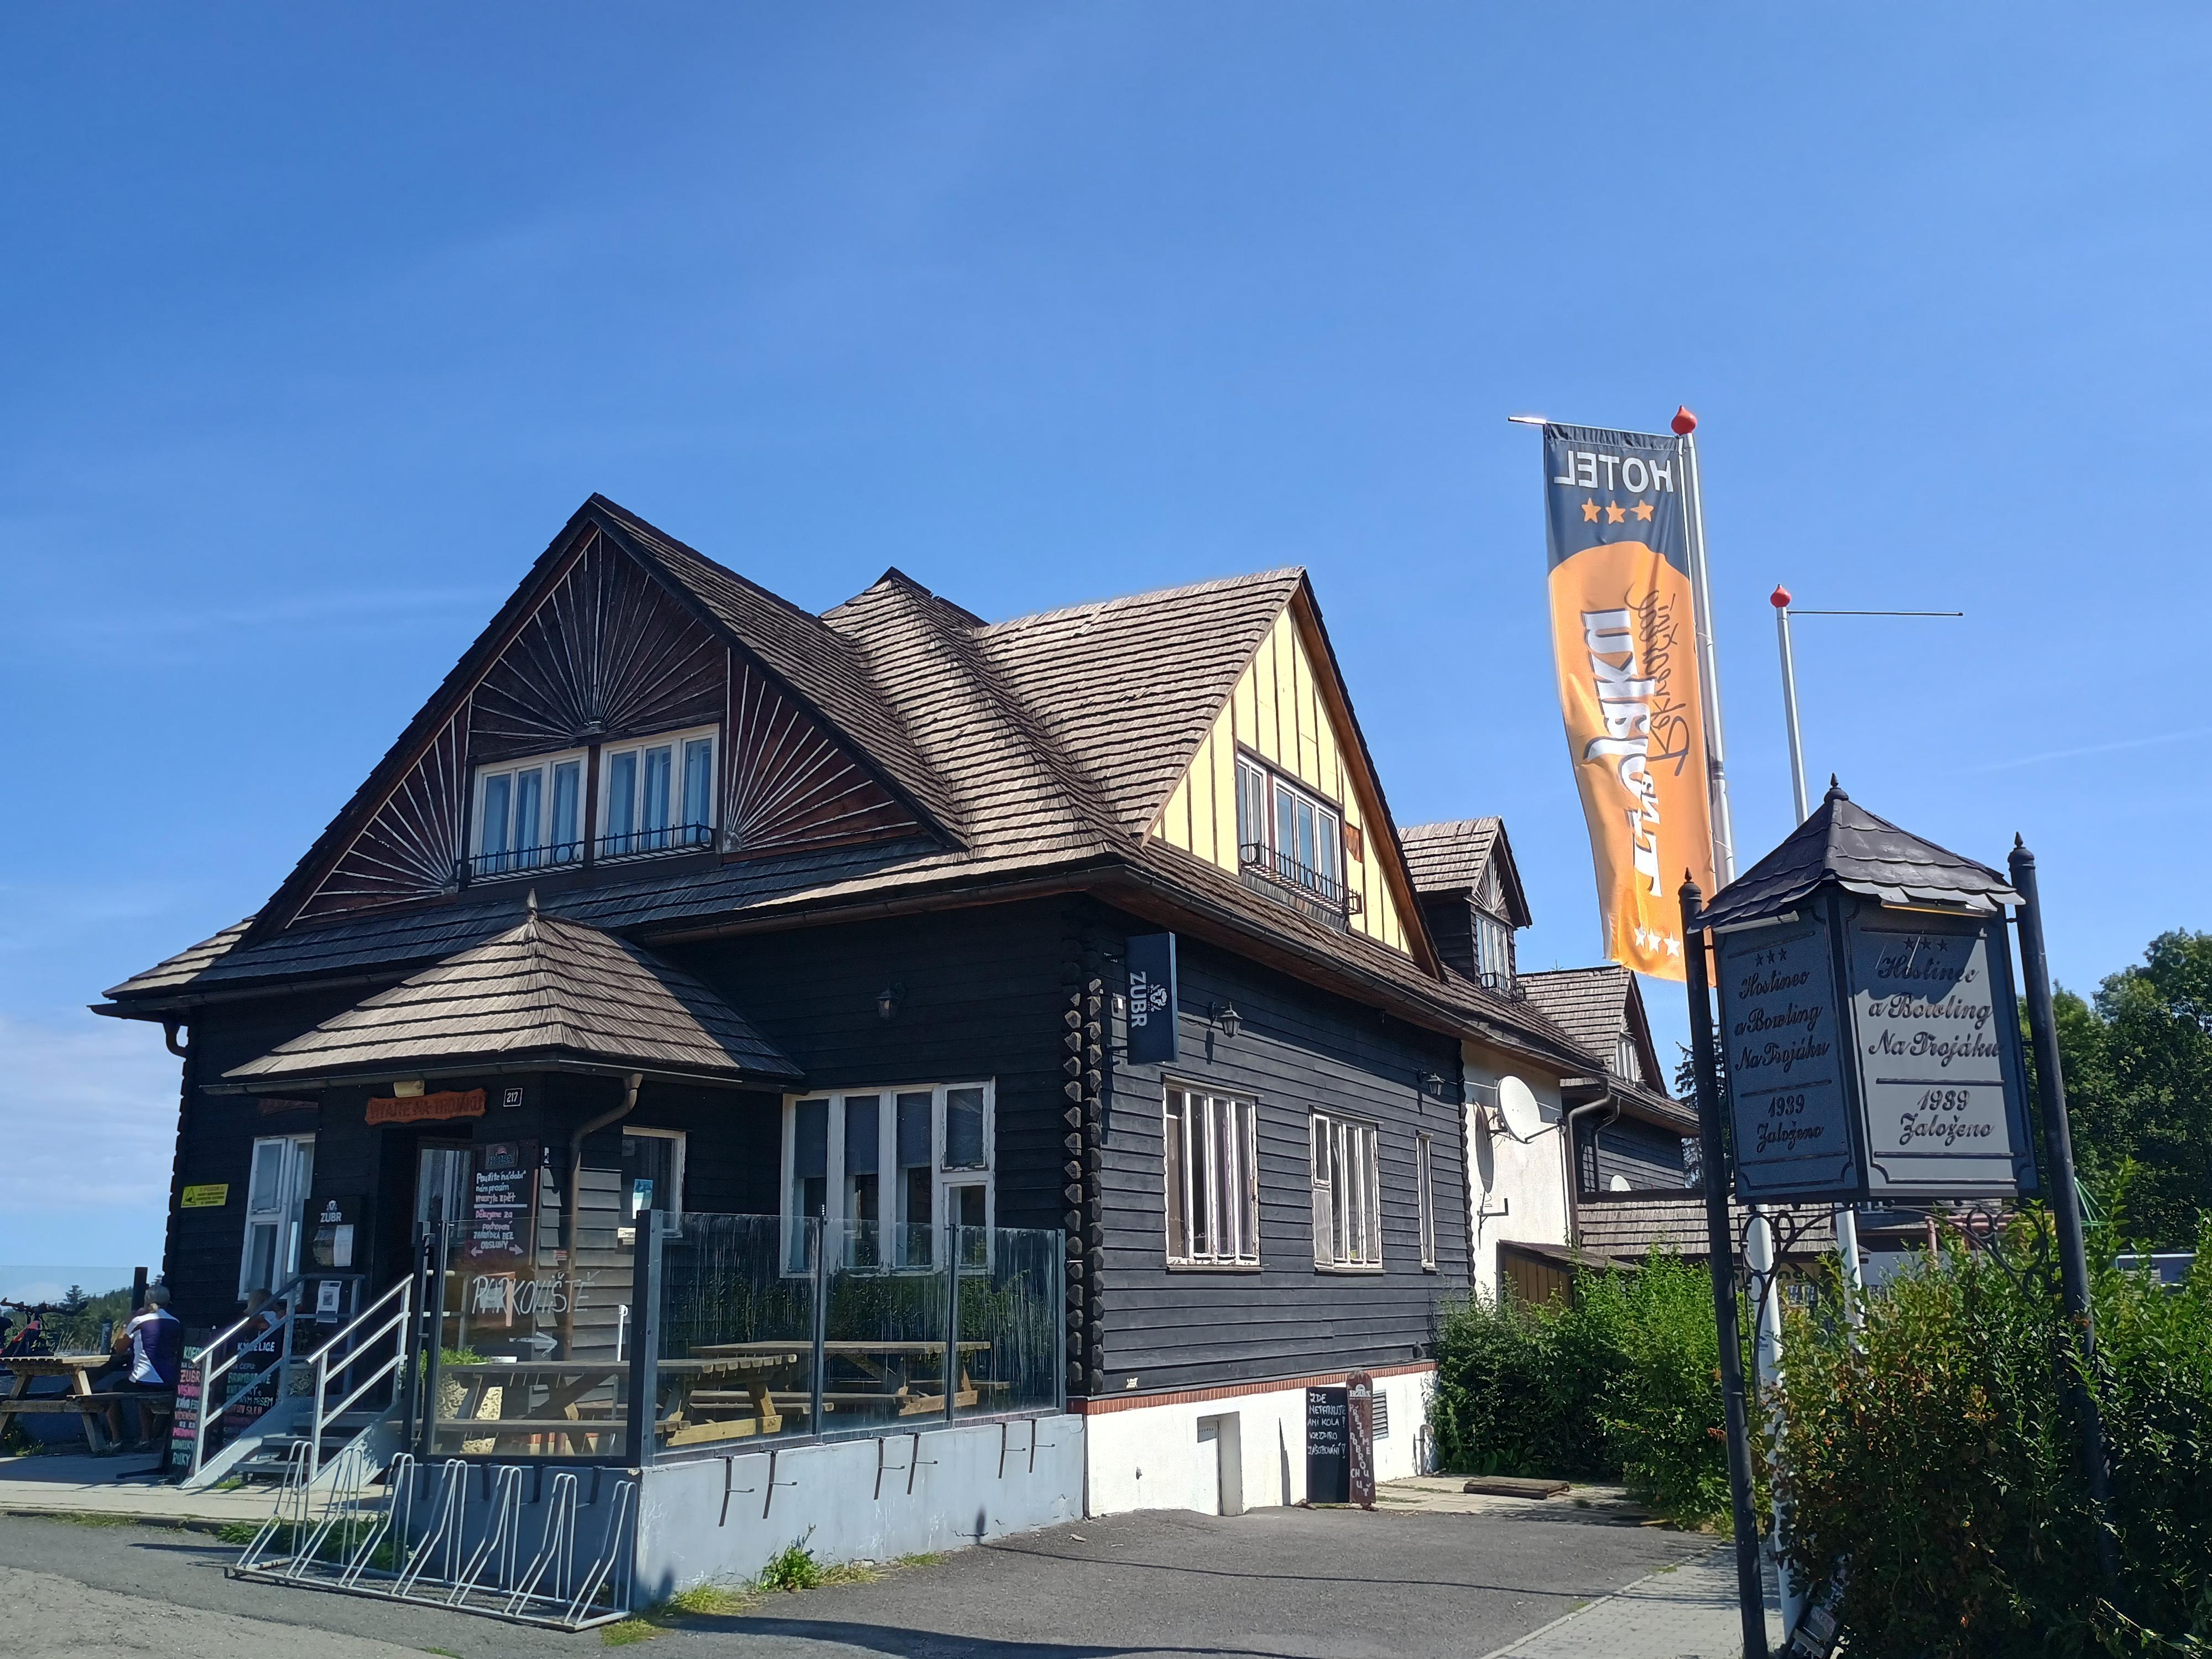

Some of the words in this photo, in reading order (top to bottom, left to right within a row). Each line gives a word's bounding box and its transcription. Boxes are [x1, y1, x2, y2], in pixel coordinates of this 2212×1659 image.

[1877, 955, 1980, 983] Hostinec
[1739, 970, 1810, 999] Hostinec
[1130, 971, 1147, 1028] ZUBR
[1868, 1001, 1888, 1018] a
[1887, 992, 1994, 1030] Bowling
[1734, 1021, 1747, 1036] a
[1746, 1002, 1823, 1033] Bowling
[1735, 1046, 1763, 1071] Na
[1762, 1035, 1830, 1073] Trojáku
[1868, 1029, 1911, 1056] Na
[1909, 1031, 2001, 1067] Trojáku
[506, 1091, 519, 1103] 217
[1768, 1094, 1805, 1118] 1939
[1917, 1089, 1971, 1112] 1939
[1756, 1121, 1824, 1154] Založeno
[1898, 1113, 1994, 1147] Založeno
[320, 1212, 342, 1223] ZUBR
[180, 1369, 201, 1383] ZUBR
[1309, 1391, 1327, 1404] ZDE
[1321, 1418, 1340, 1427] KOLA
